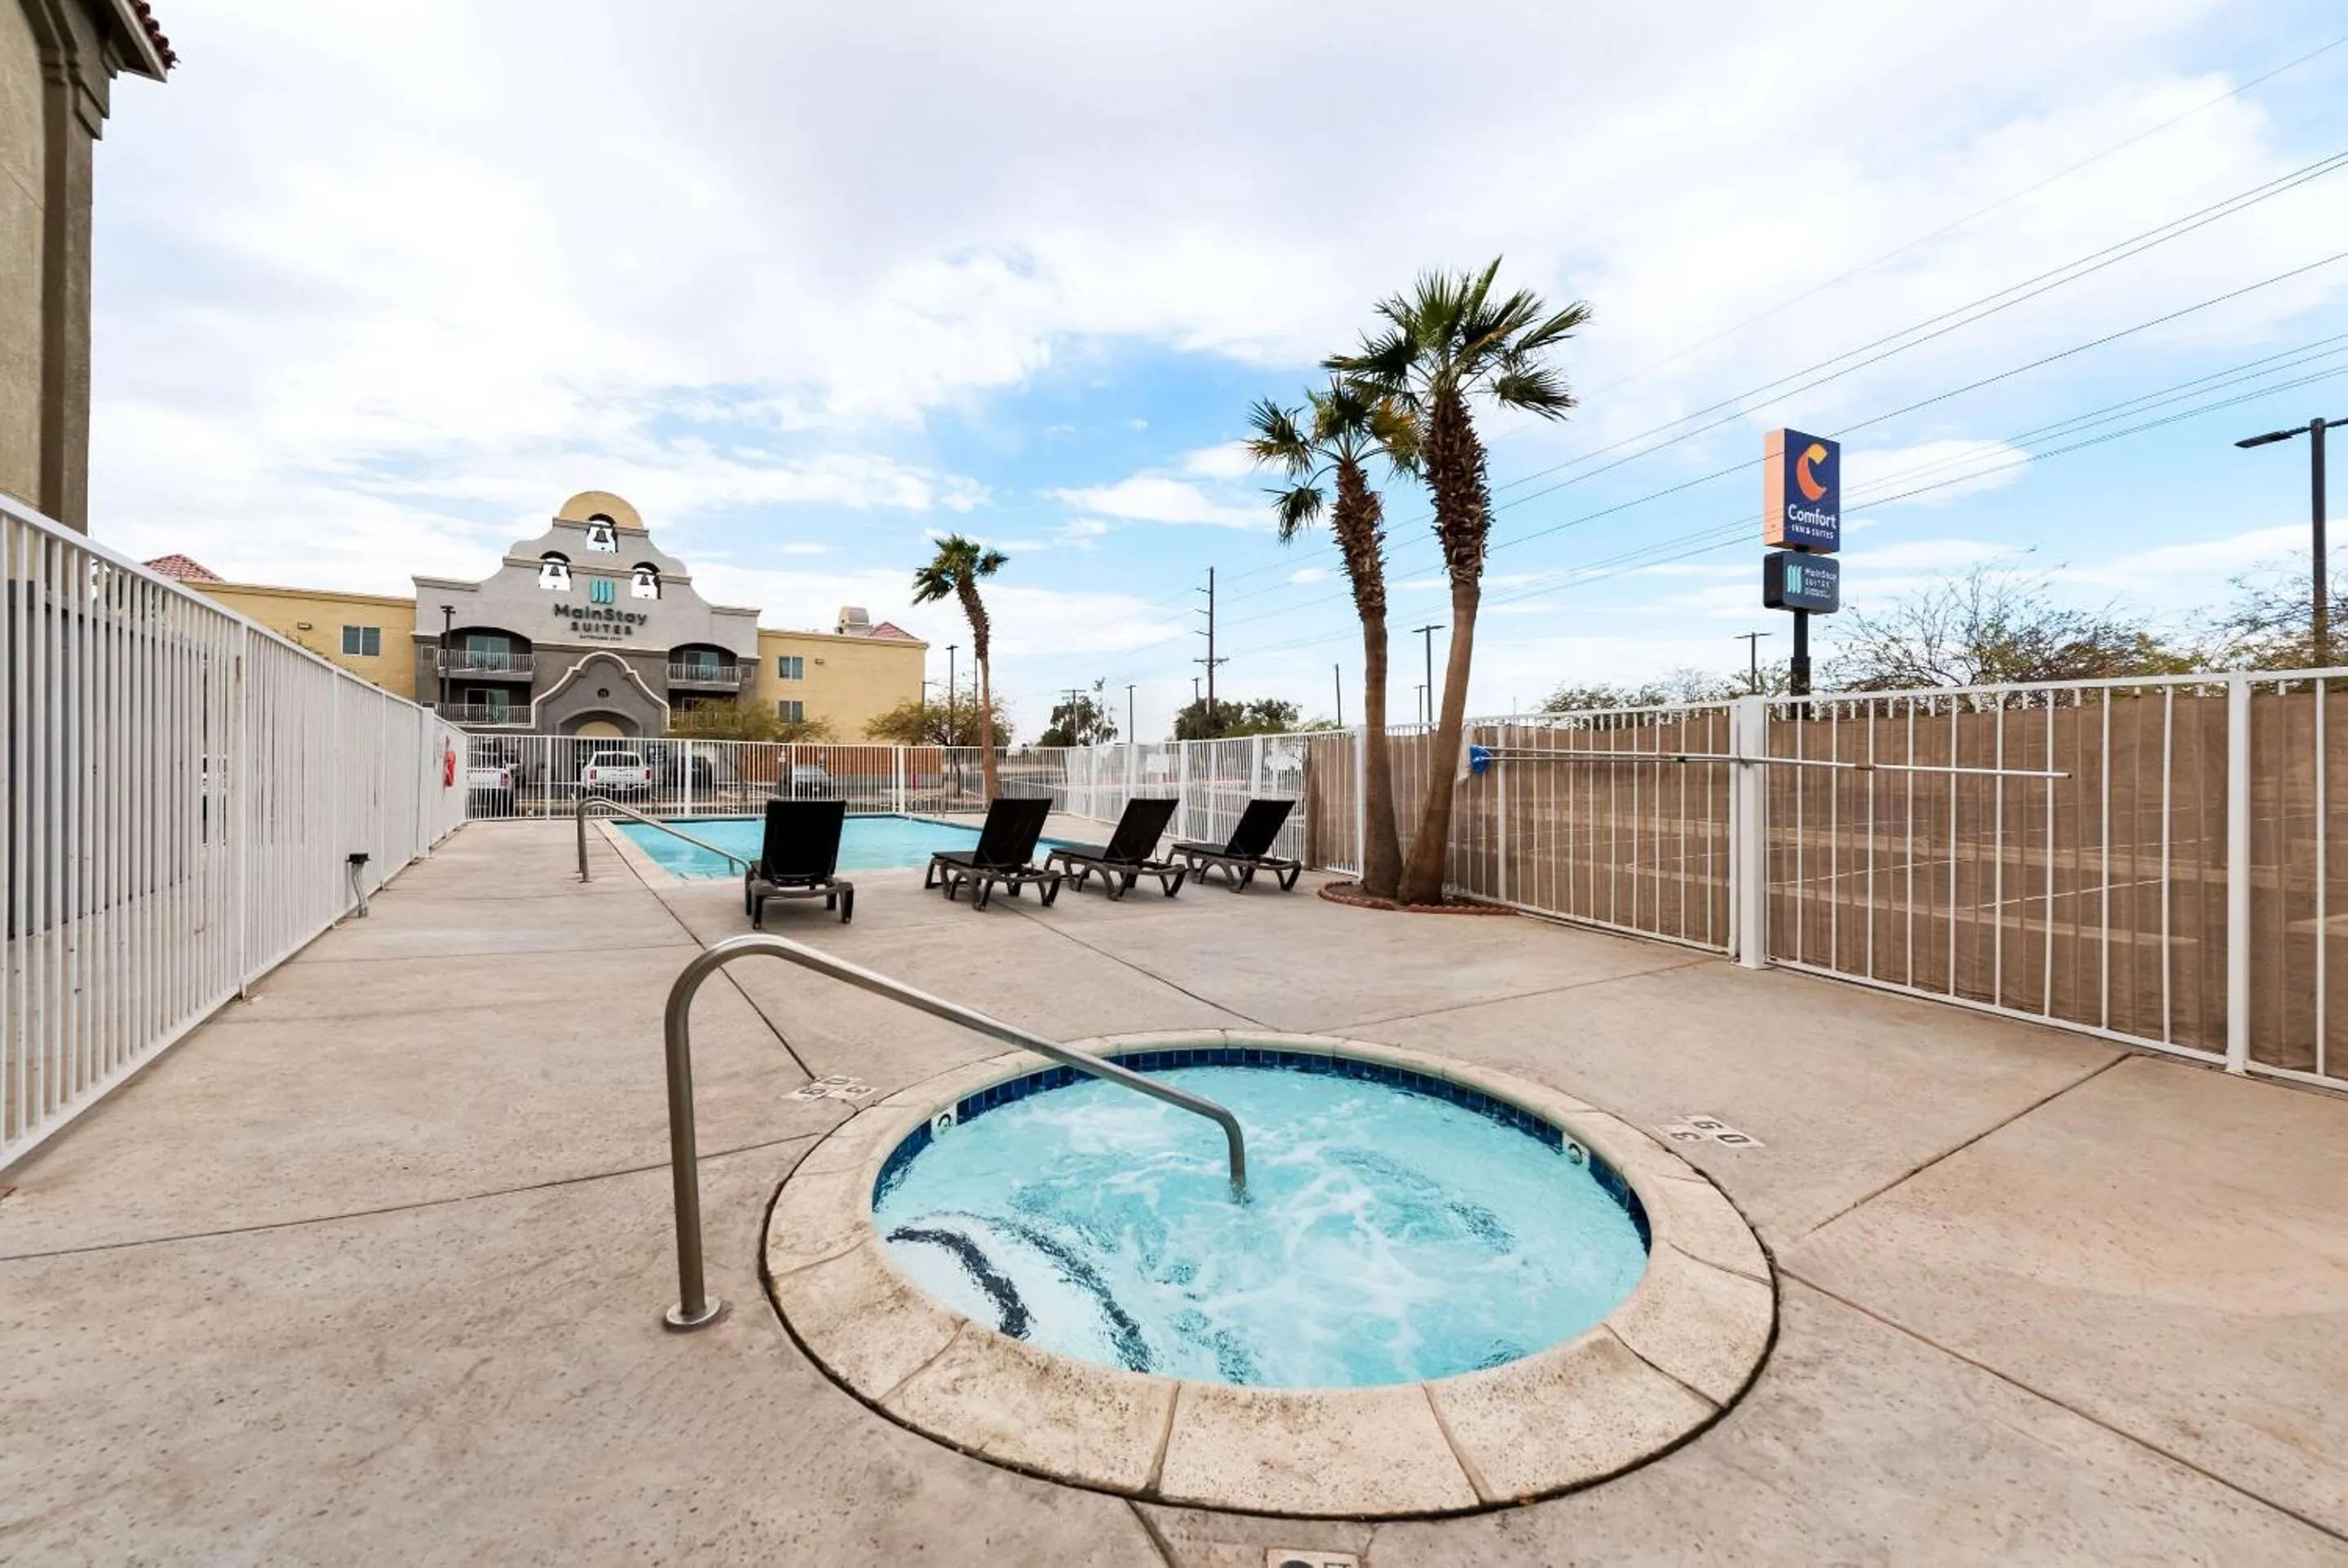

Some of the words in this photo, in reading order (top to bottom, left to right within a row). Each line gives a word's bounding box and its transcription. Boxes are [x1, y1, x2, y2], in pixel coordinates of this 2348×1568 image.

[1788, 503, 1837, 529] Comfort
[1791, 523, 1805, 532] INN
[1811, 528, 1834, 539] SUITES
[555, 603, 648, 626] MainStay
[571, 621, 633, 635] SUITES
